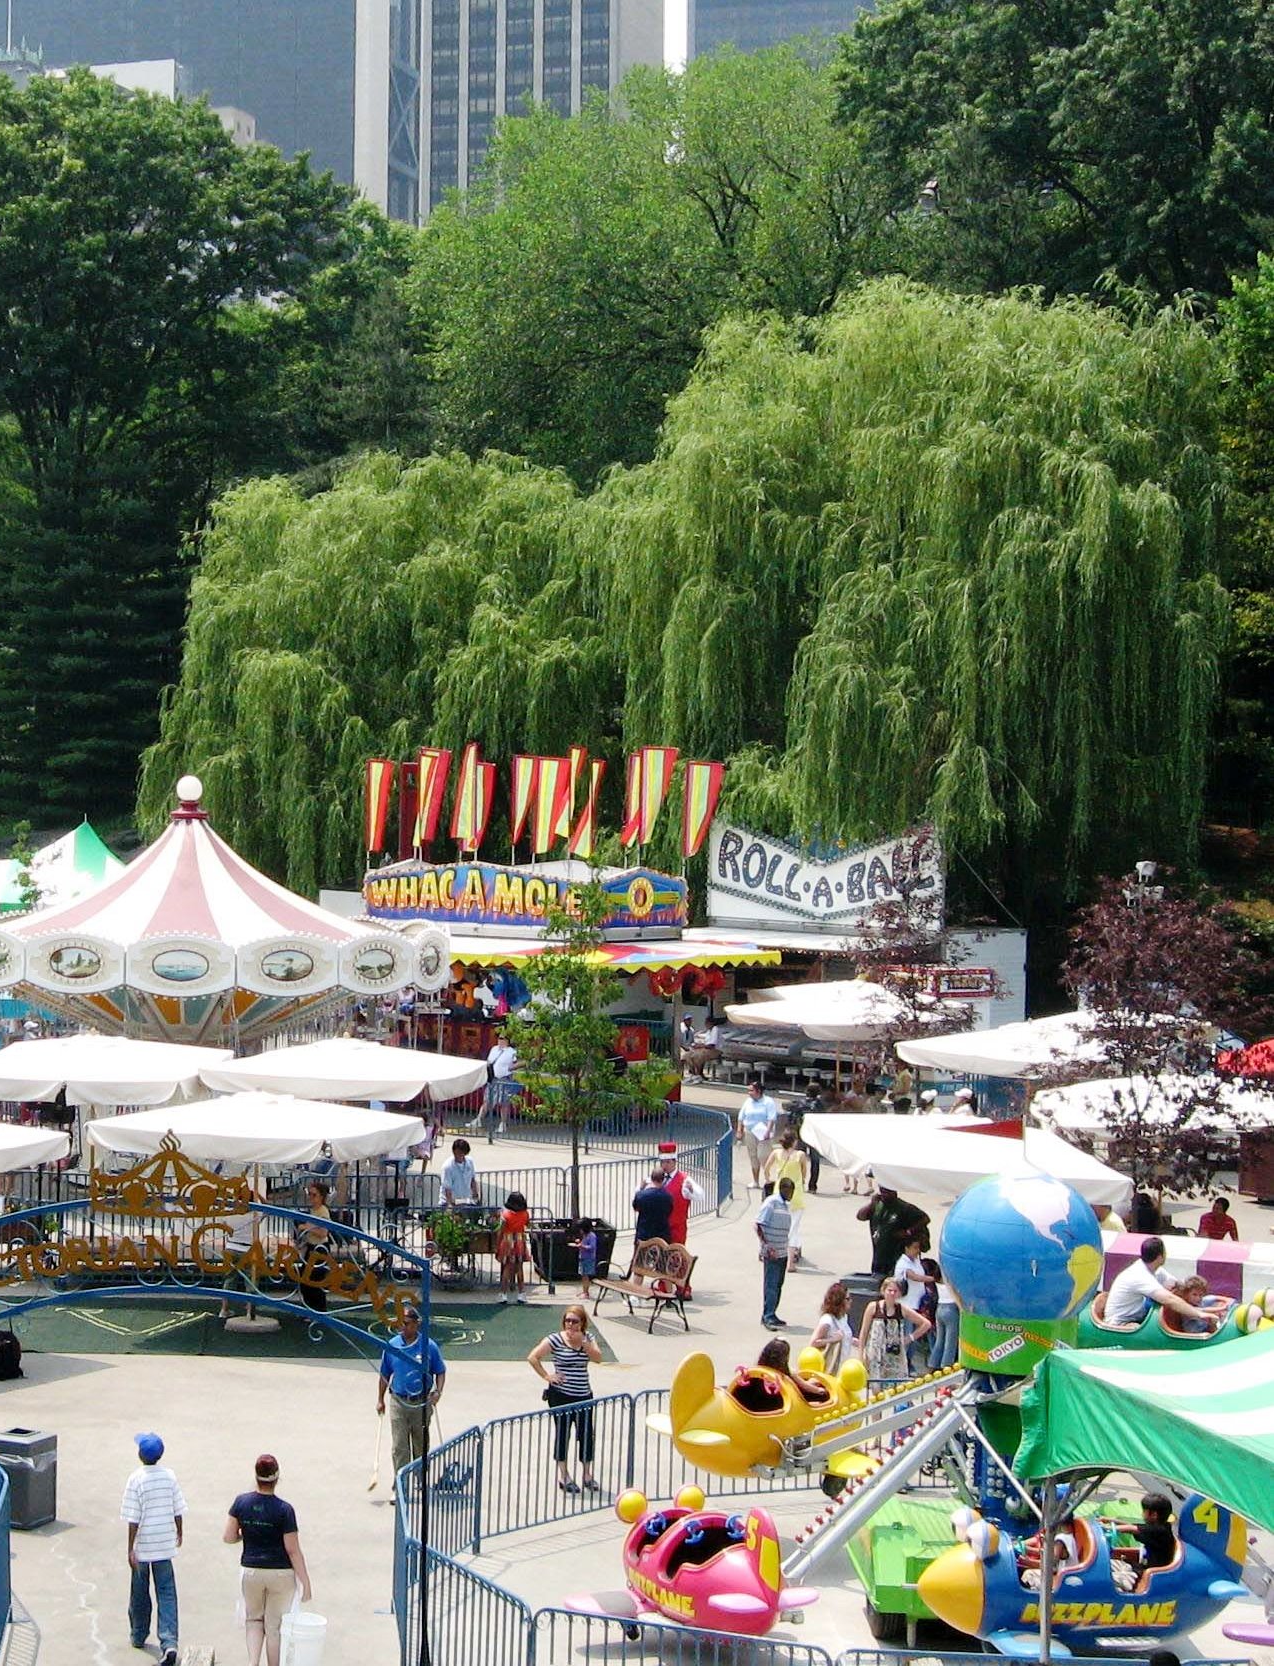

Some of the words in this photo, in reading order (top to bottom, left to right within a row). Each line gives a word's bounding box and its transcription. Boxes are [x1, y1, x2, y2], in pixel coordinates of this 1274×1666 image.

[718, 829, 802, 902] ROLL
[371, 869, 456, 910] WHAC
[464, 868, 487, 910] A
[190, 1222, 419, 1328] GARDENS
[988, 1336, 1025, 1361] TOKYO
[1192, 1498, 1220, 1533] 4
